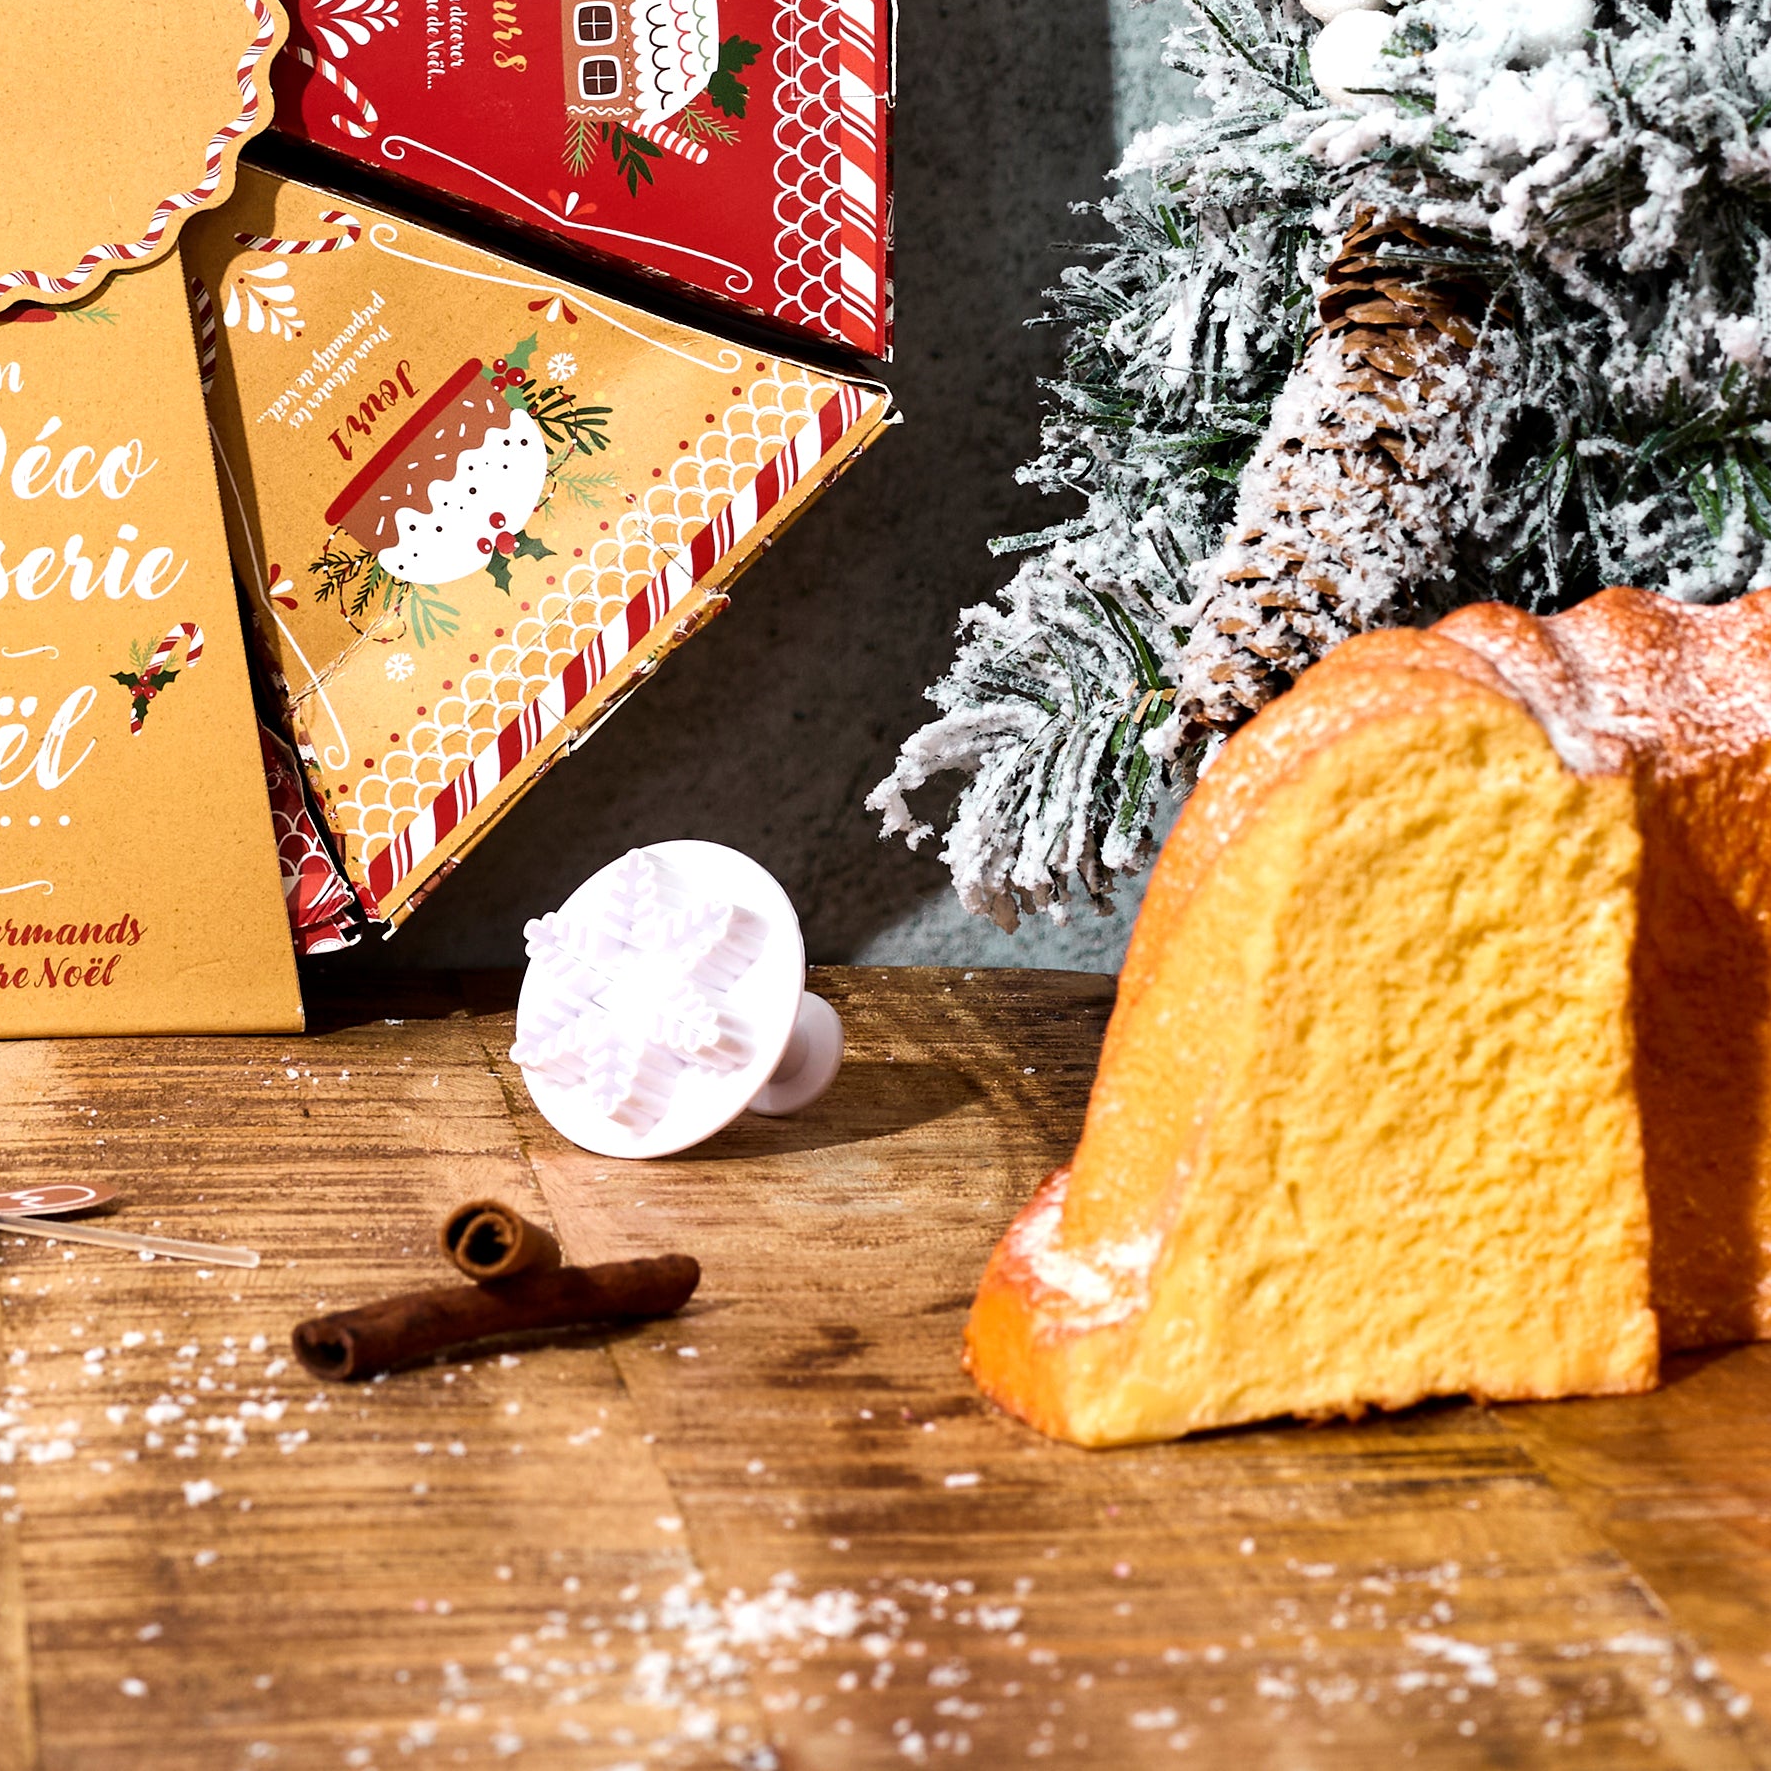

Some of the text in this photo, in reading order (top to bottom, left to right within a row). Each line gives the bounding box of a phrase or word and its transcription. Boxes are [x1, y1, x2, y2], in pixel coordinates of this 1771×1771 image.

[427, 16, 444, 37] de
[449, 6, 468, 69] décorer
[427, 40, 446, 89] Noël...
[493, 51, 527, 72] 8
[257, 289, 386, 422] préparatifs de Noël...
[289, 325, 392, 428] Pour débuter les
[328, 360, 420, 460] Jour 1
[32, 953, 121, 990] Noël
